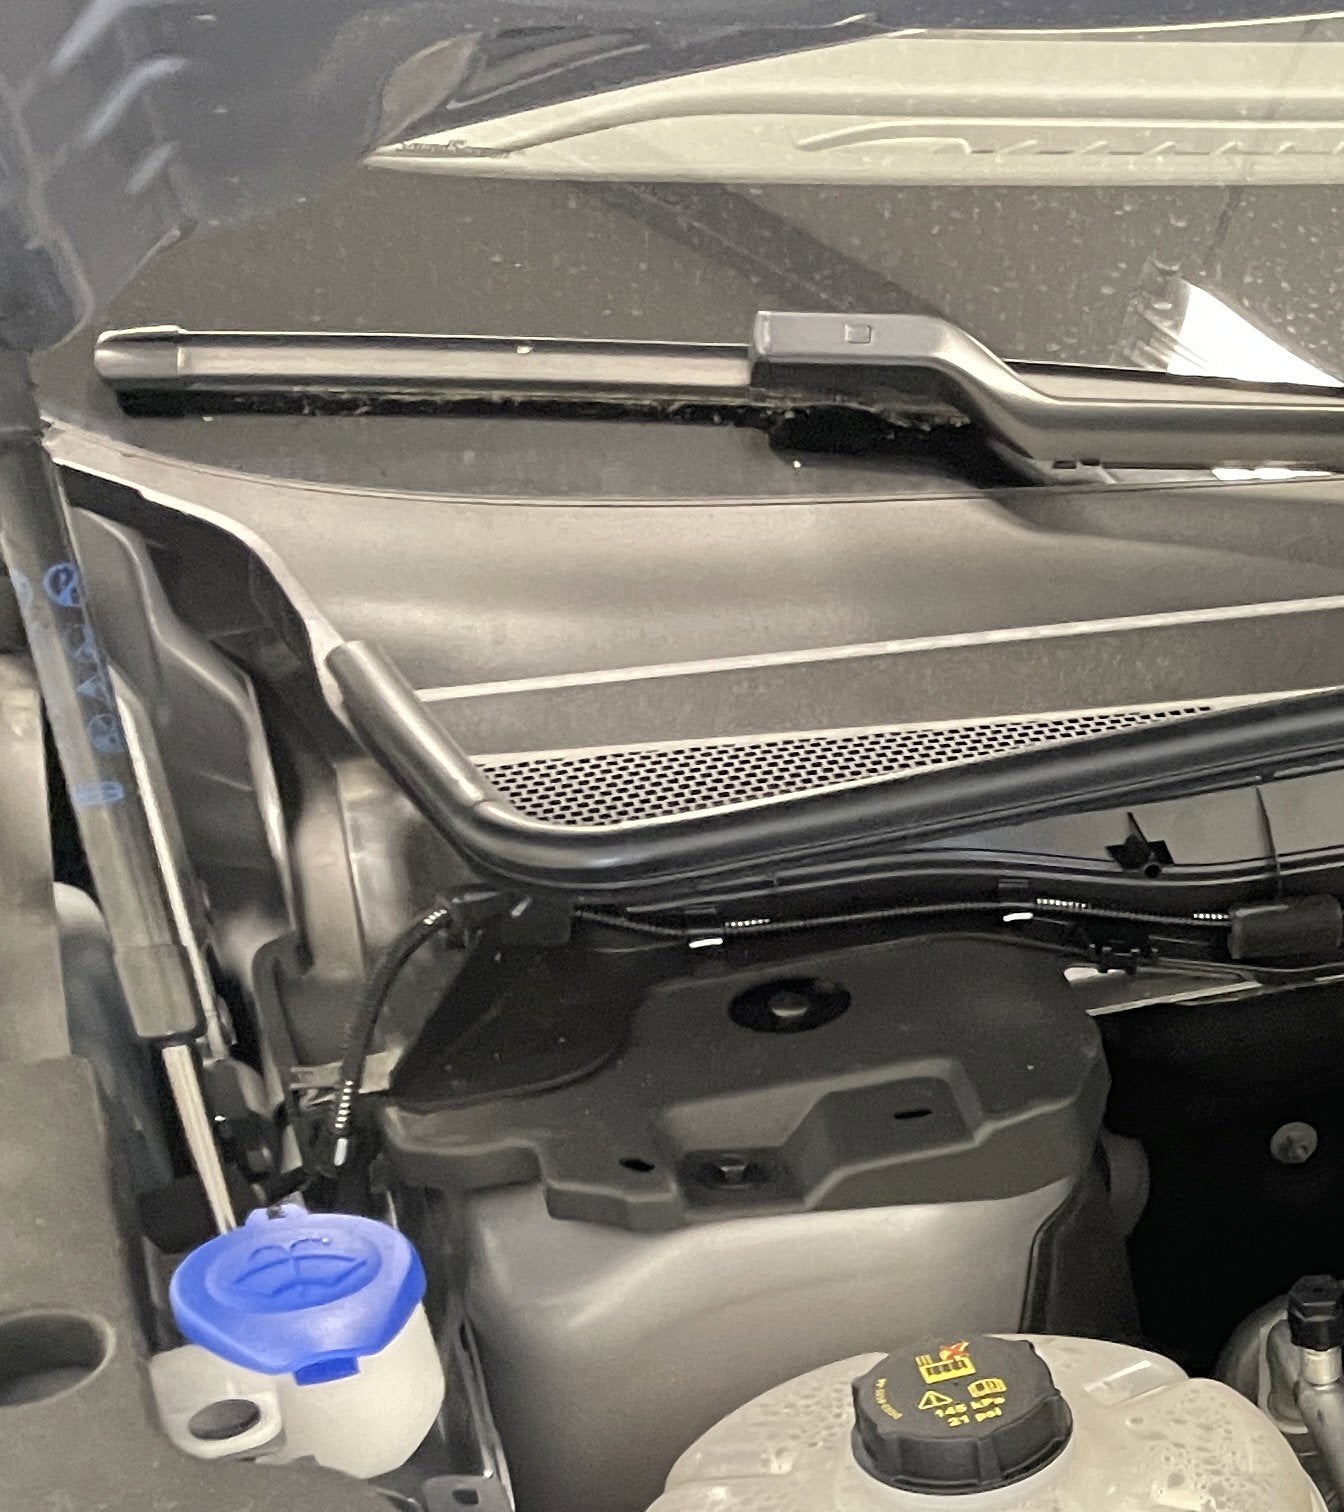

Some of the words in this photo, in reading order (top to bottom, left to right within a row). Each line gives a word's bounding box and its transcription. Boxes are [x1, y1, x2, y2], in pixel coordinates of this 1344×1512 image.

[934, 1403, 968, 1418] 145
[947, 1414, 970, 1427] 21
[975, 1407, 1003, 1423] psi
